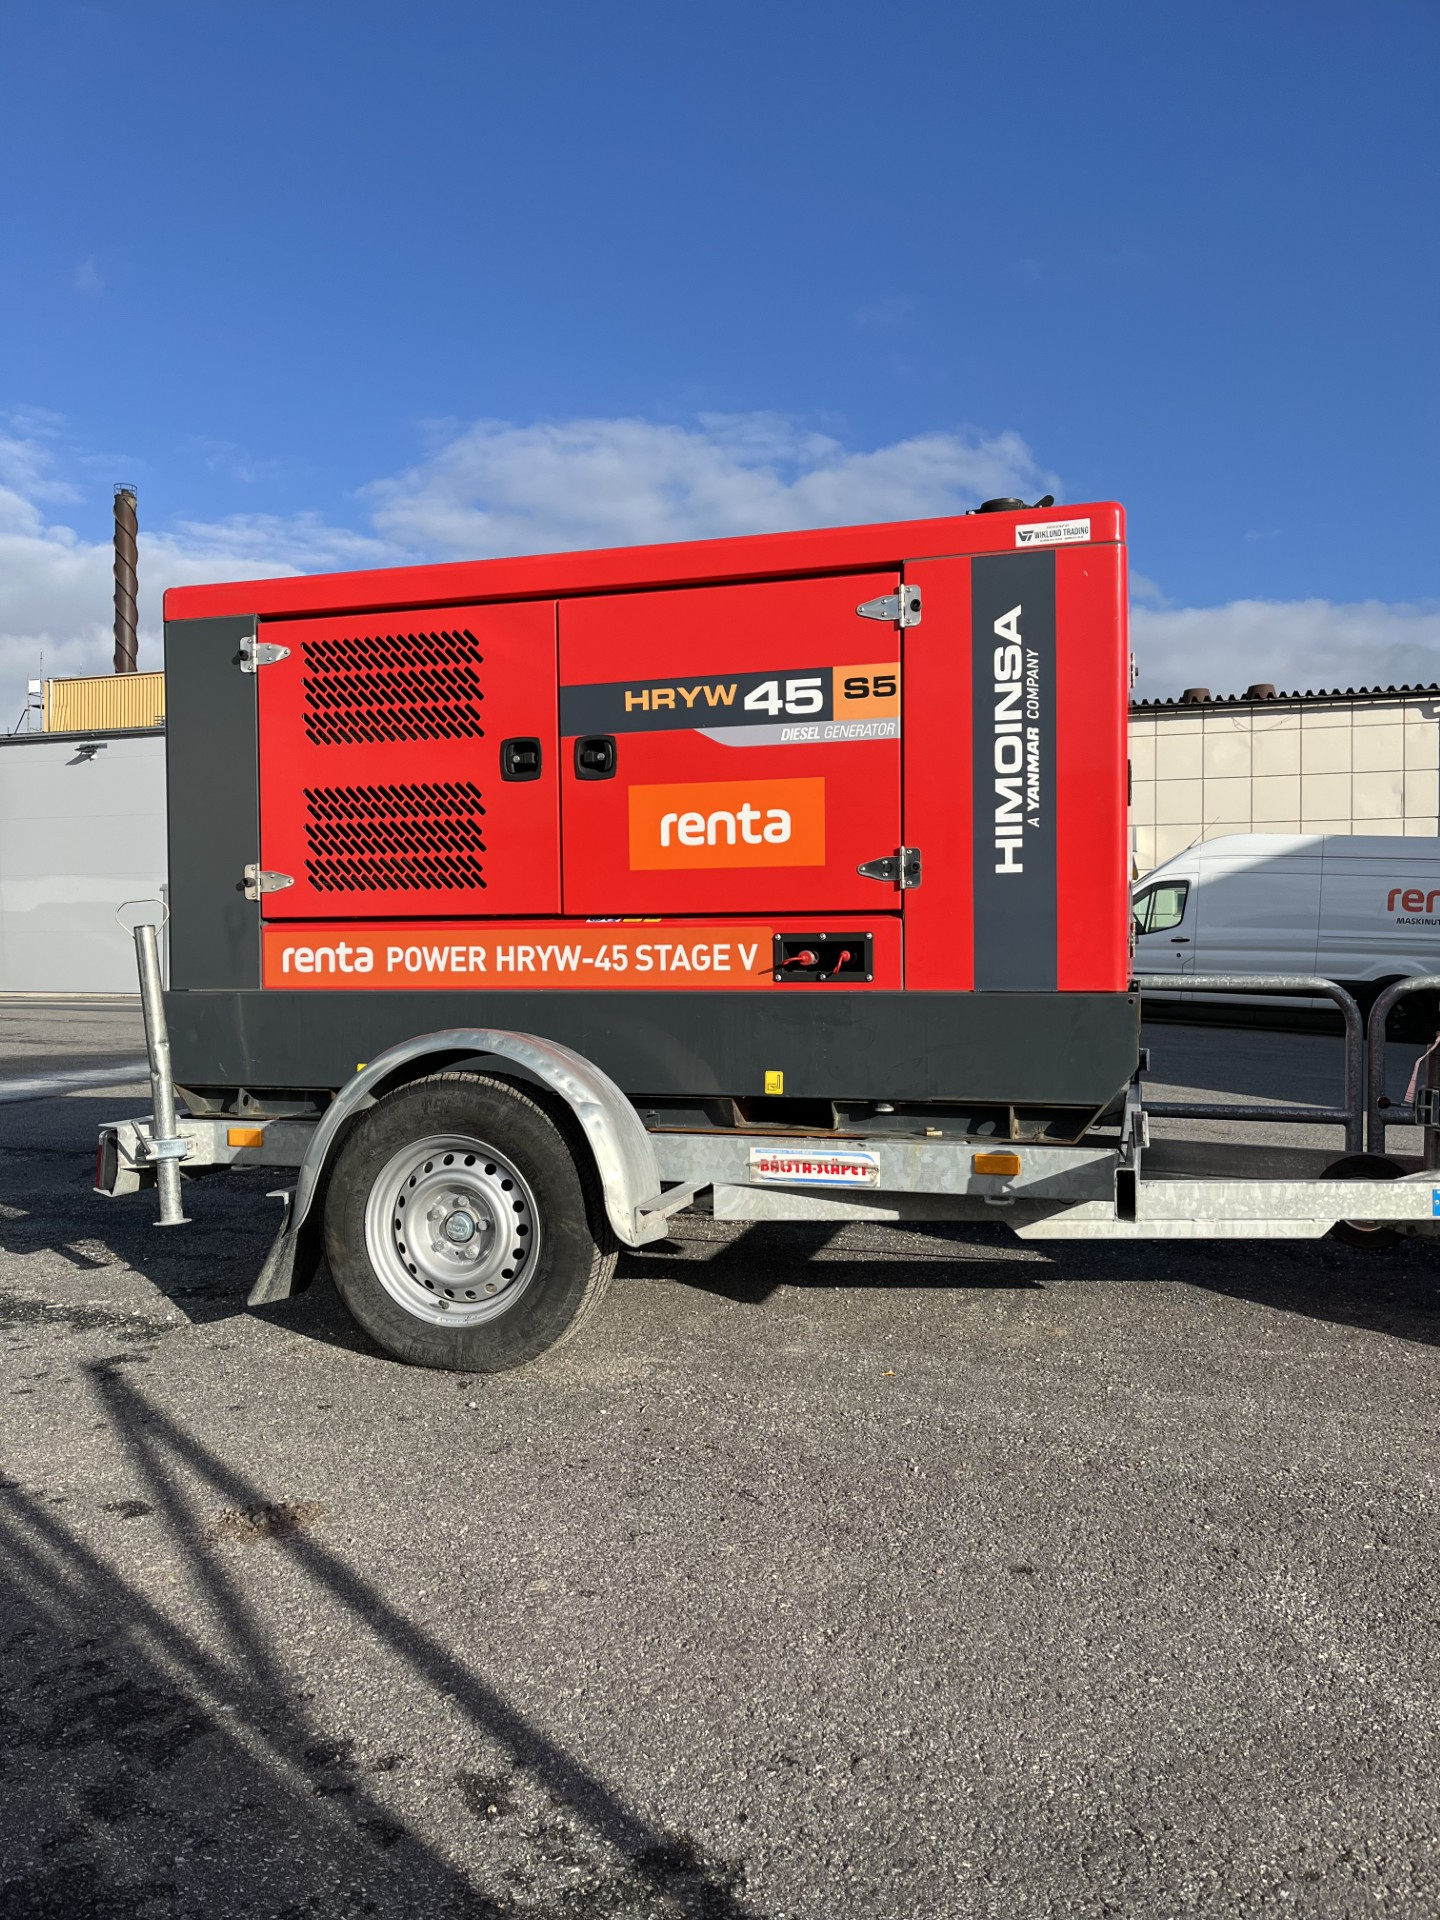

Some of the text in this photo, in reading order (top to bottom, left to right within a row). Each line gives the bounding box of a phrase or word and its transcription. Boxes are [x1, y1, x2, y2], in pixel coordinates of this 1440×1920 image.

[1034, 528, 1062, 540] WIKLUND
[1063, 526, 1089, 537] TRADING
[624, 675, 897, 716] HRYW 45 S5
[780, 722, 896, 742] DIESEL GENERATOR
[994, 604, 1023, 873] HIMOINSA
[1026, 648, 1040, 828] A YANMAR COMPANY
[660, 802, 791, 847] renta
[282, 942, 758, 973] renta POWER HRYW-45 STAGE V
